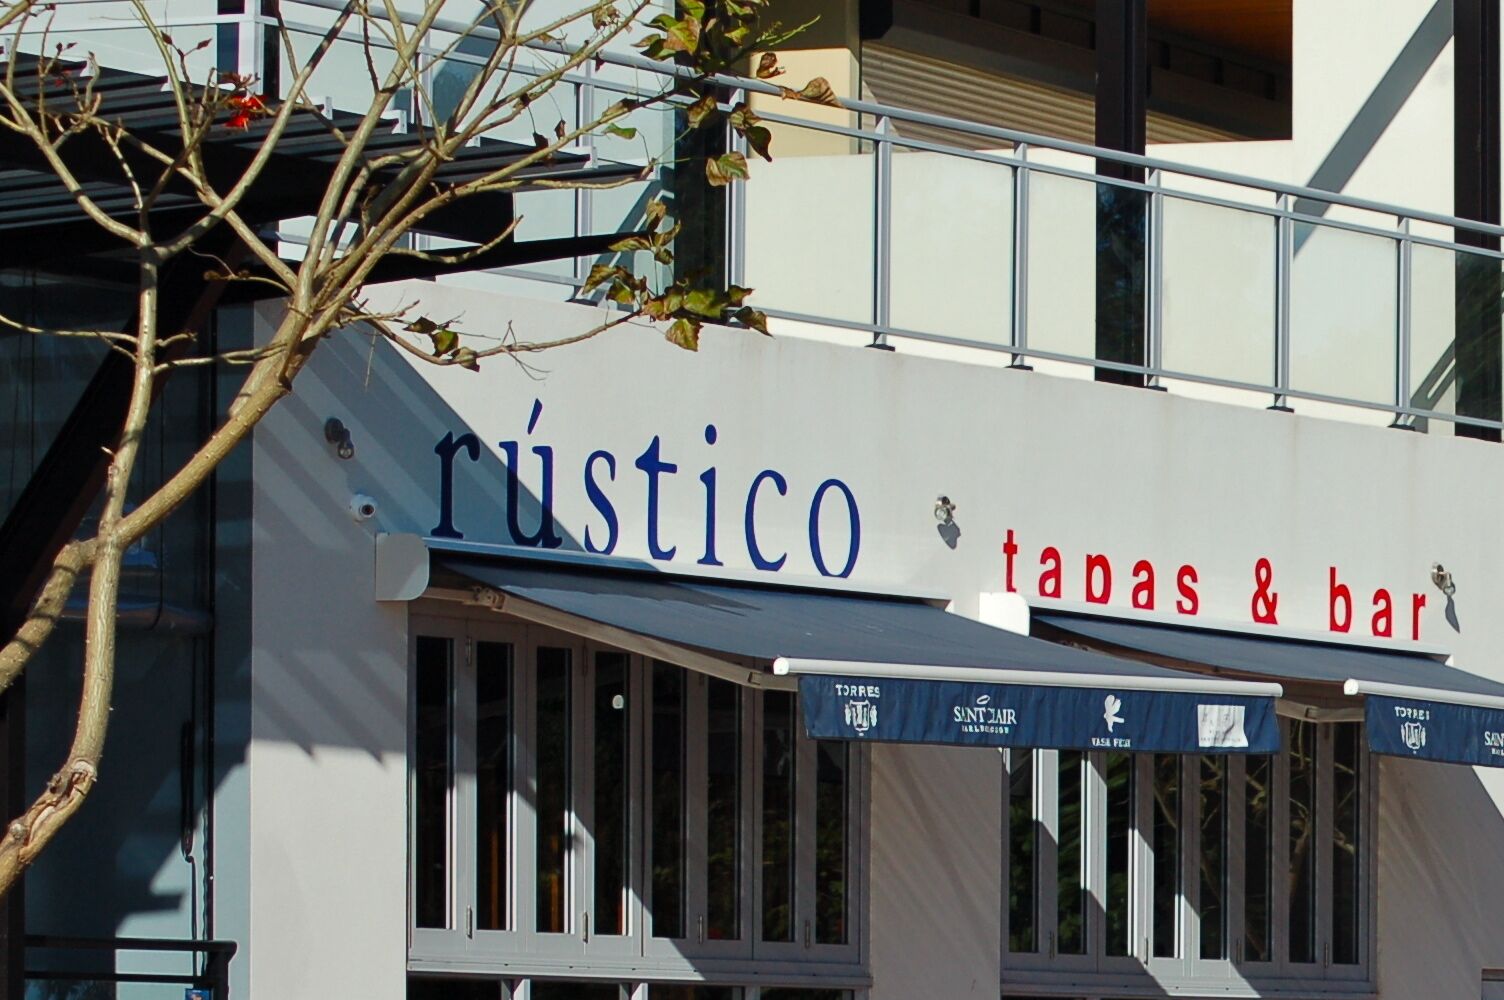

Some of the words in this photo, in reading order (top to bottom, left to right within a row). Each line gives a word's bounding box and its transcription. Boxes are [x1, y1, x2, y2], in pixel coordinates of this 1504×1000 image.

[430, 397, 861, 579] rústico
[1003, 529, 1199, 615] tapas
[1251, 557, 1278, 625] &
[1330, 566, 1426, 641] bar
[835, 684, 881, 698] TORRES
